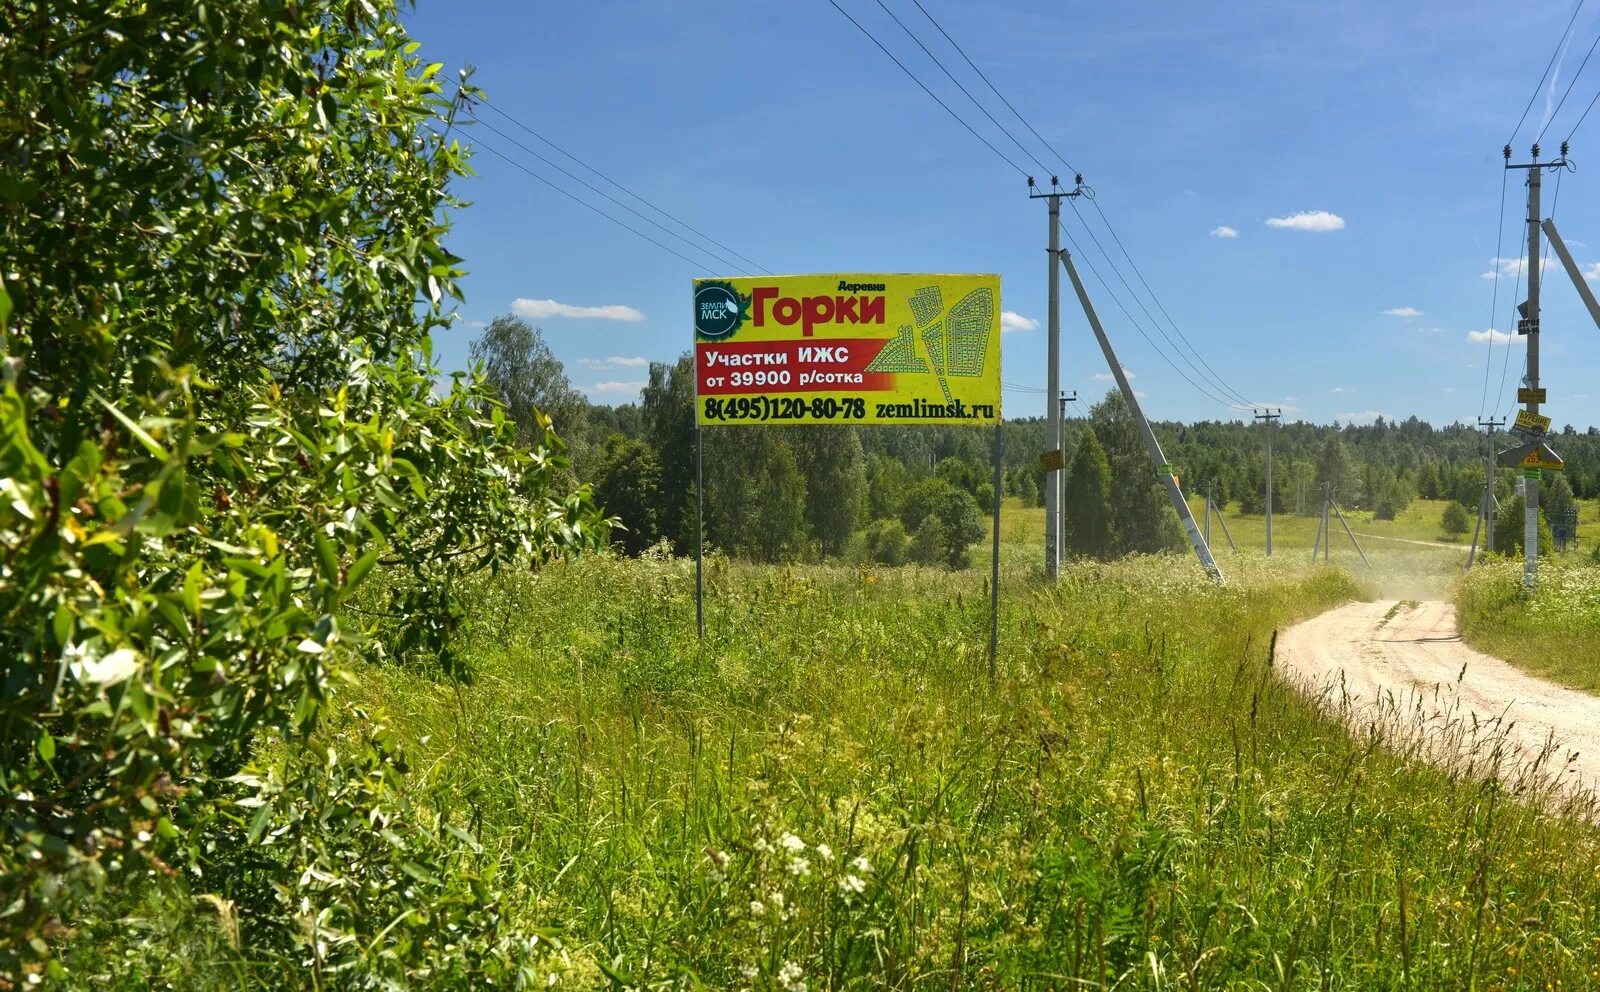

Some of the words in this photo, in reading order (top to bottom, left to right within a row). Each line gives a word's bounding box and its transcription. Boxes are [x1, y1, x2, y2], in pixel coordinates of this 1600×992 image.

[837, 280, 886, 293] Деревня
[700, 302, 728, 310] ЗЕМЛИ
[752, 287, 885, 337] Горки
[701, 309, 728, 320] МСК
[705, 351, 788, 367] Участки
[798, 346, 849, 363] ИЖС
[706, 375, 725, 388] от
[730, 370, 791, 386] 39900
[799, 370, 863, 385] р/сотка
[704, 396, 866, 421] 8(495)120-80-78
[876, 398, 994, 420] zemlimsk.ru
[1519, 412, 1548, 426] БУРЕНИЕ
